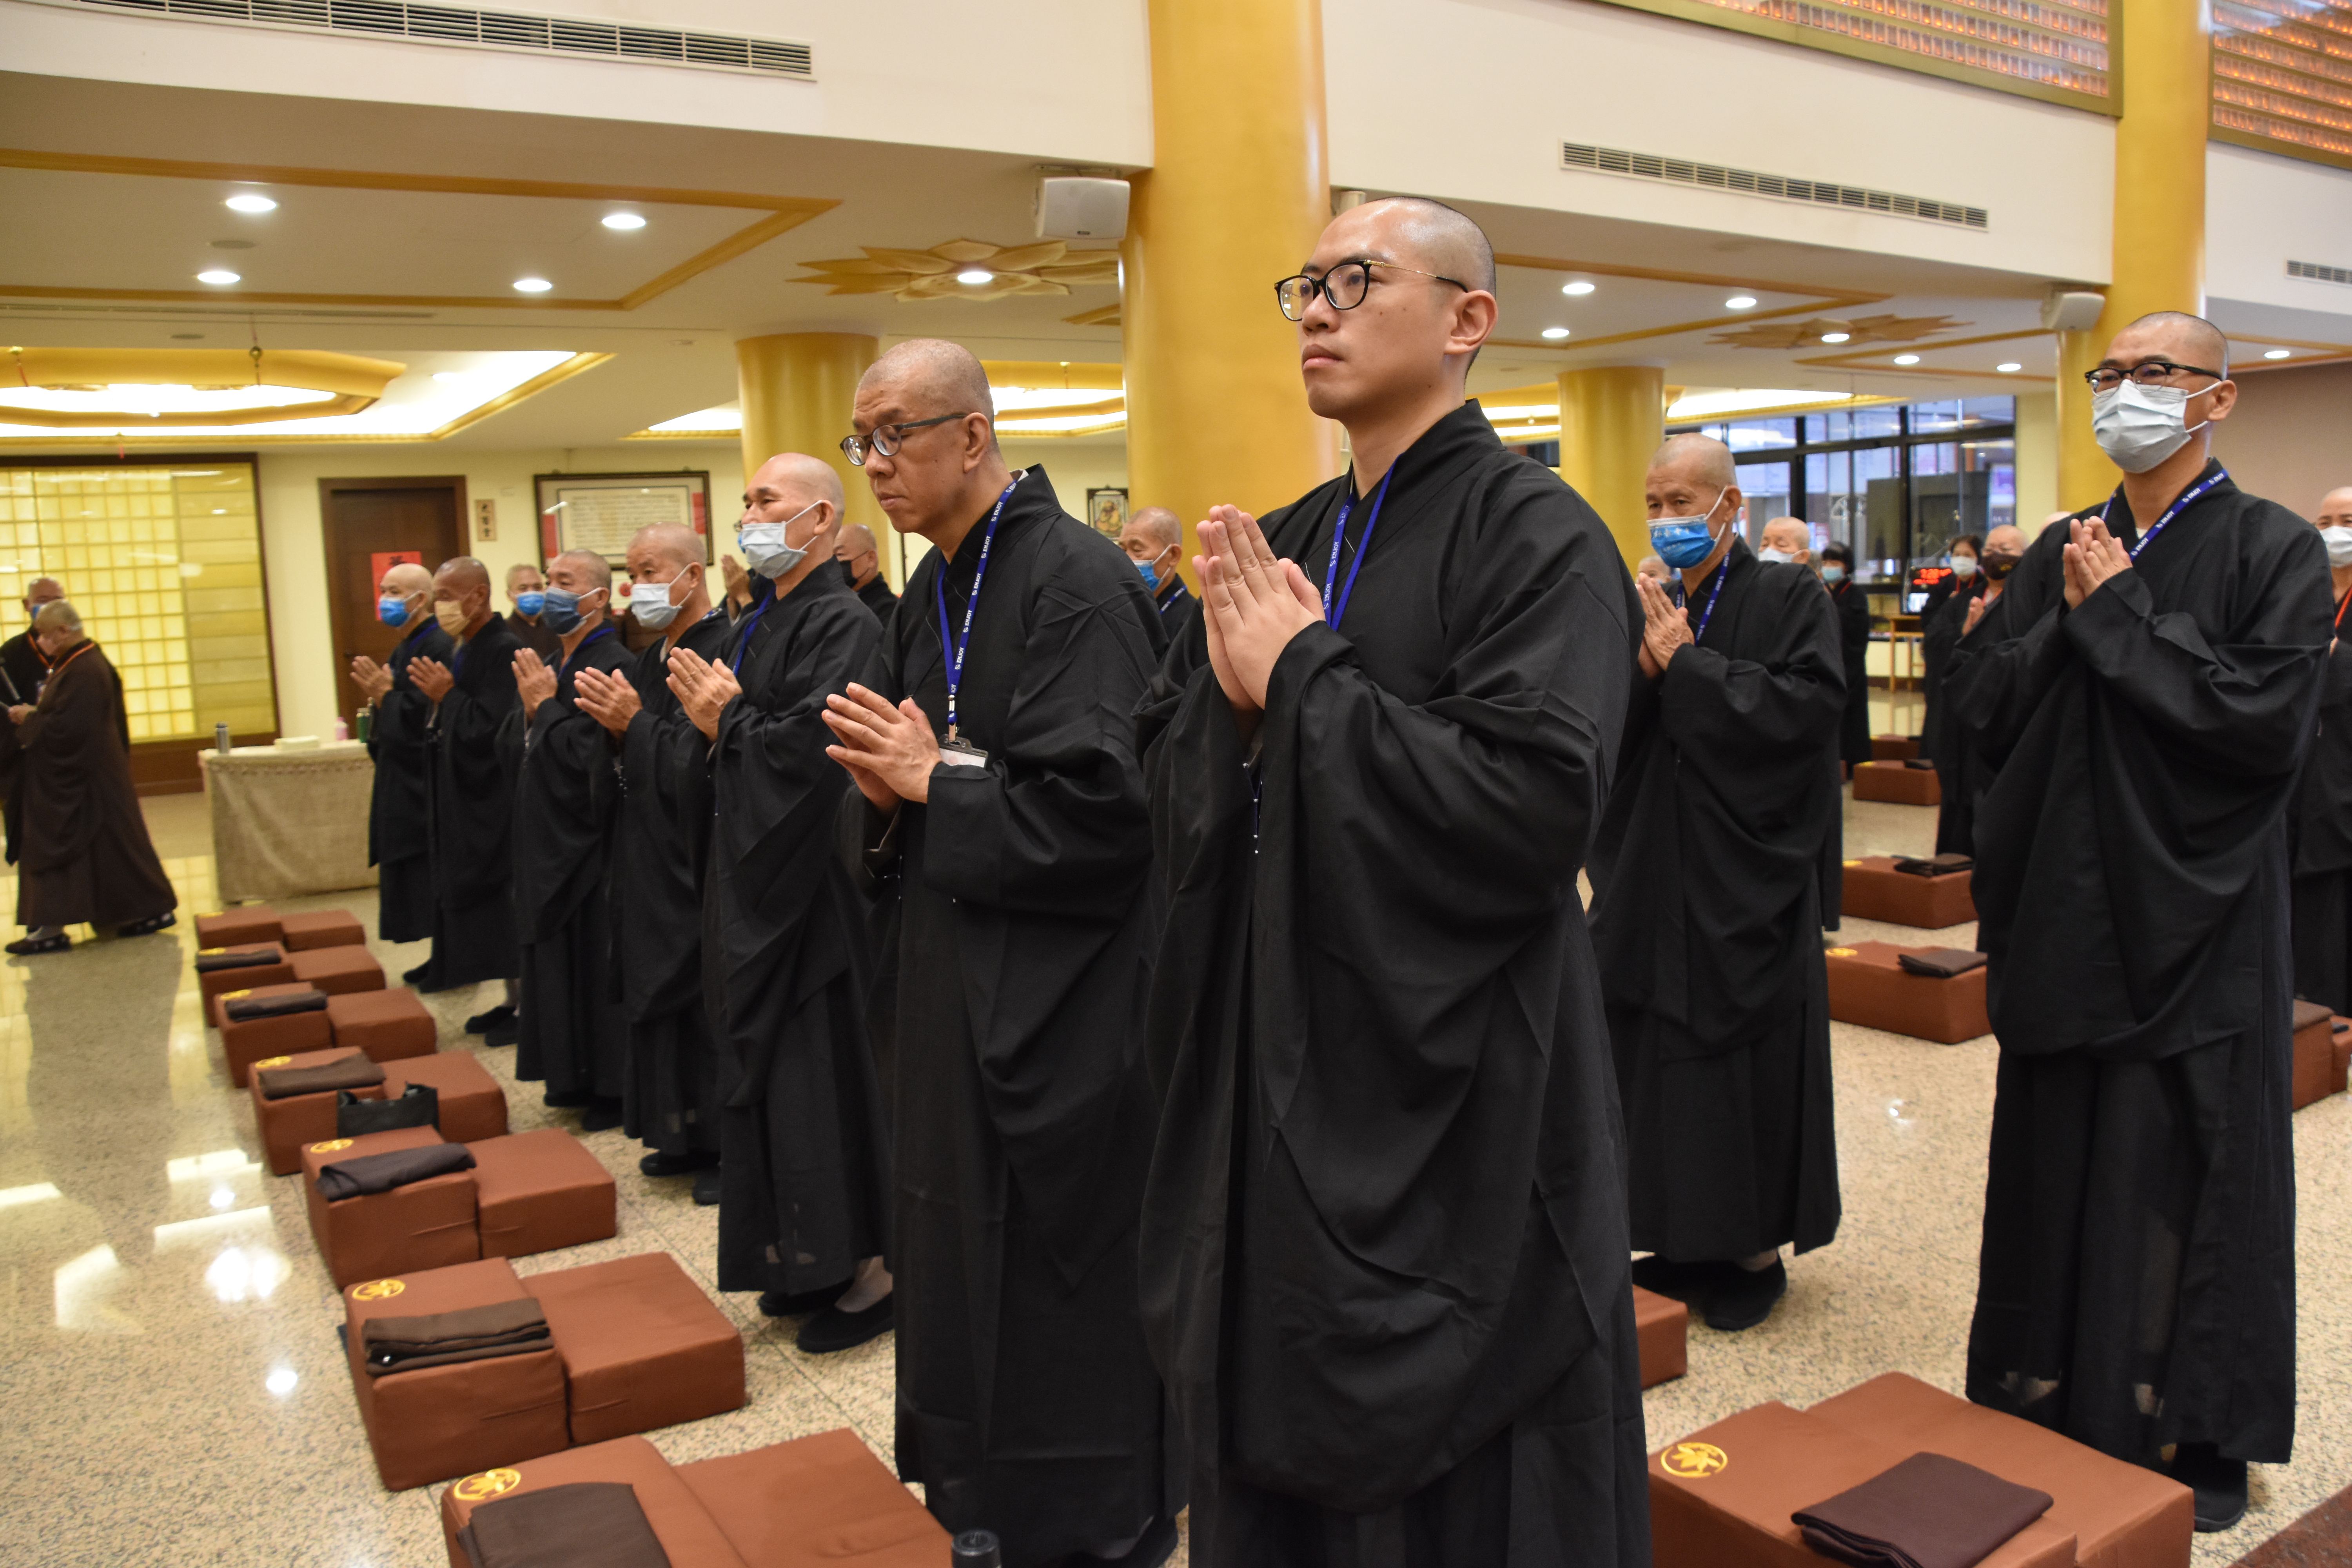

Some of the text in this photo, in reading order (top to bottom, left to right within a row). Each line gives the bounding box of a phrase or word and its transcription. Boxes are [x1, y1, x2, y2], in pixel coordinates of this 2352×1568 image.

[2187, 488, 2201, 499] ENJOY
[994, 501, 1003, 515] ENJOY
[2161, 511, 2174, 524] ENJOY
[2136, 537, 2149, 551] ENJOY
